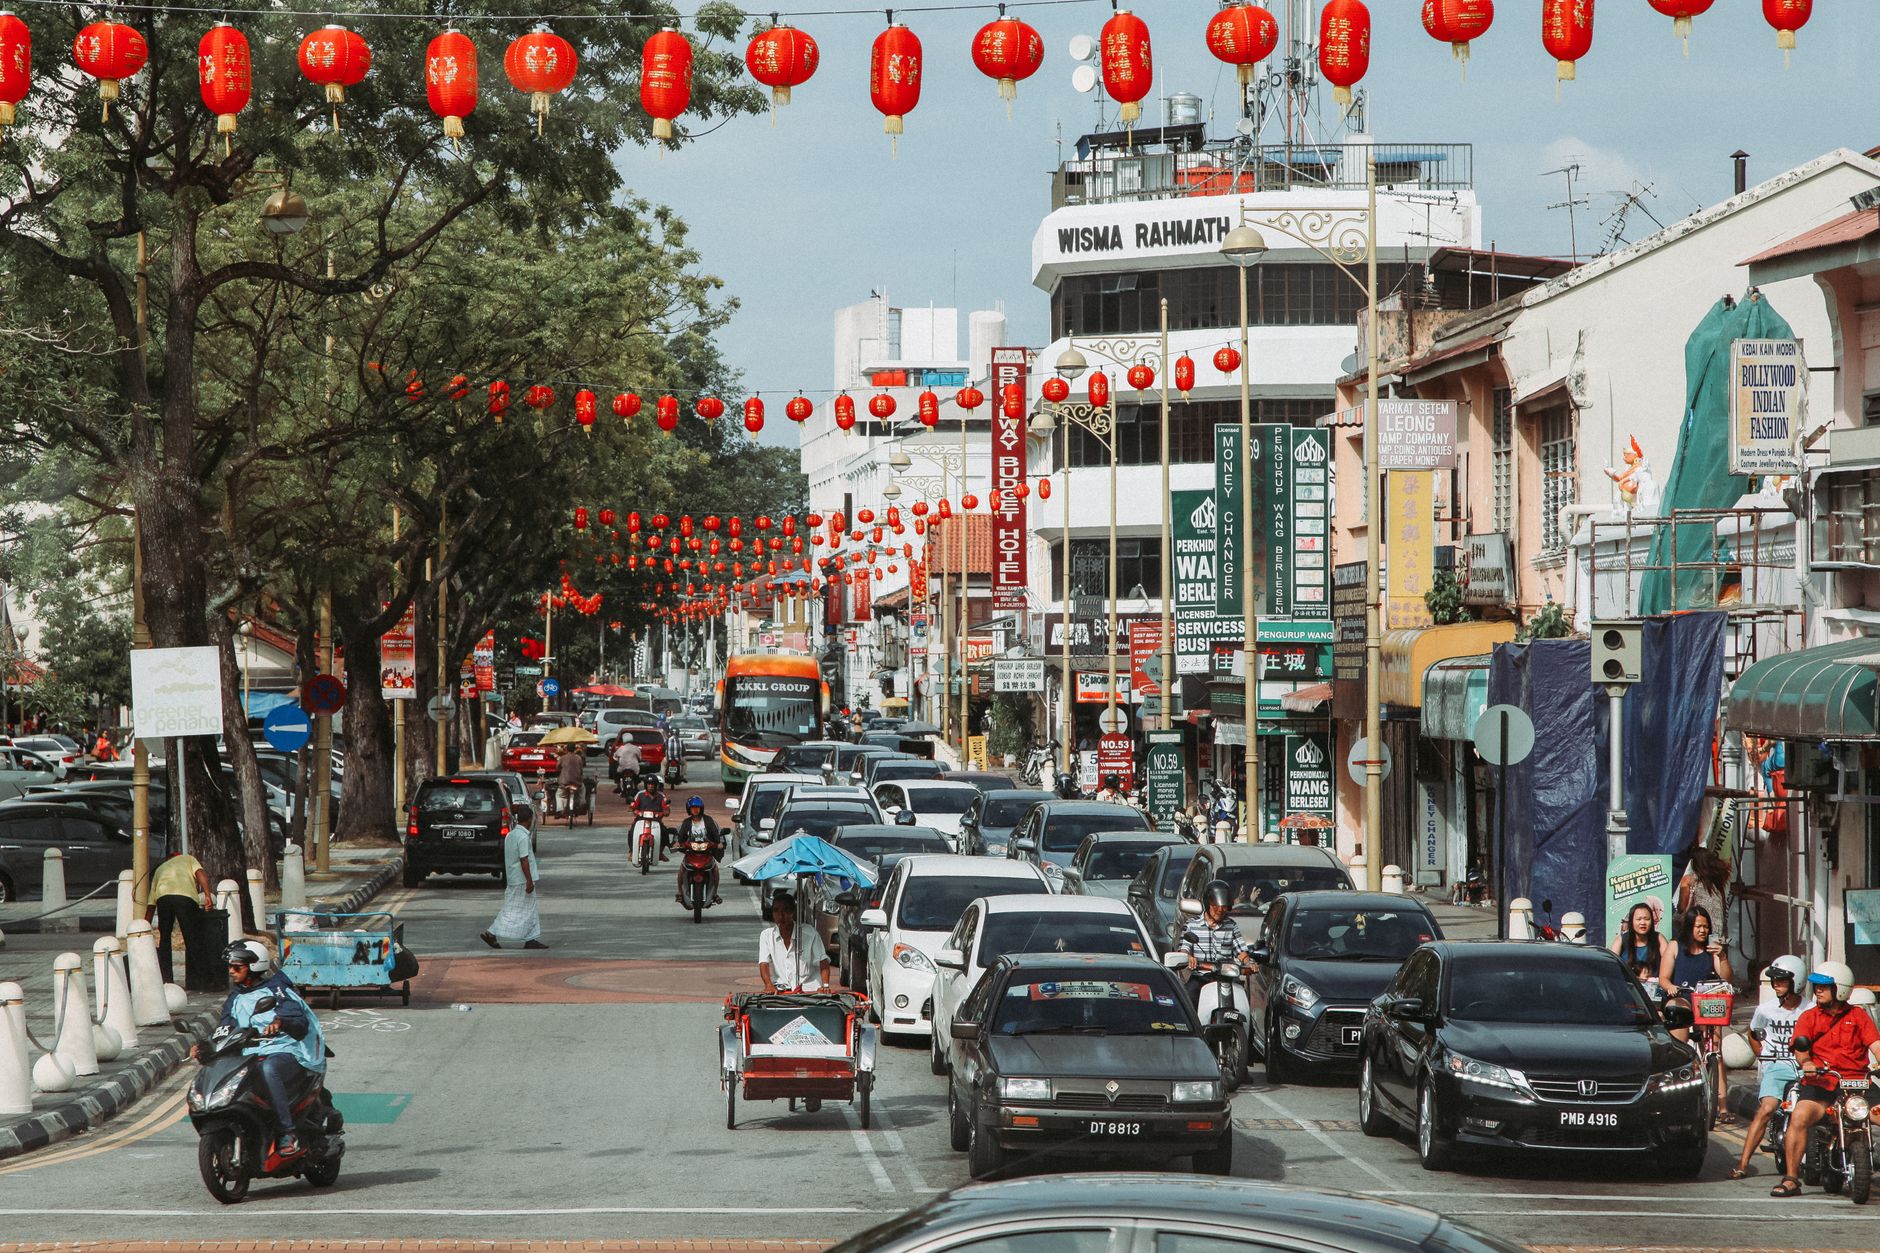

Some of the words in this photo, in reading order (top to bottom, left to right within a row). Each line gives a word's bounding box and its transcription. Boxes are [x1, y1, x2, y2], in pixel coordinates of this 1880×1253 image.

[1058, 225, 1123, 253] WISMA
[1135, 216, 1230, 248] RAHMATH
[1742, 343, 1757, 356] KEDAI
[1760, 344, 1774, 355] KAIN
[1776, 343, 1796, 355] MODEN
[1742, 365, 1796, 387] BOLLYWOOD
[1377, 402, 1413, 414] YARIKAT
[1419, 403, 1449, 414] SETEM
[1753, 391, 1786, 412] INDIAN
[1386, 416, 1435, 431] LEONG
[1750, 417, 1789, 439] FASHION
[1378, 433, 1402, 444] TAMP
[1405, 433, 1449, 444] COMPANY
[1418, 446, 1452, 455] ANTIQUES
[1771, 449, 1786, 457] Punjabi
[1223, 436, 1233, 498] MONEY
[1274, 427, 1283, 495] PENGURUP
[1381, 455, 1387, 464] &
[1390, 455, 1413, 464] PAPER
[1415, 456, 1440, 465] MONEY
[1741, 459, 1757, 467] Costume
[1759, 459, 1778, 469] Jewellery
[1000, 457, 1019, 521] BUDGET
[1273, 504, 1284, 537] WANG
[1177, 539, 1215, 552] PERKHID
[1000, 529, 1019, 583] HOTEL
[1223, 511, 1233, 599] CHANGER
[1275, 546, 1283, 614] BERLESEN
[1179, 582, 1215, 601] BERLE
[1177, 610, 1215, 619] LICENSED
[1178, 621, 1245, 634] SERVICESS
[1259, 631, 1305, 639] PENGURUP
[1307, 631, 1333, 639] WANG
[736, 683, 768, 691] KKKL
[770, 683, 810, 692] GROUP
[137, 705, 203, 725] greener
[155, 716, 219, 735] penang
[1101, 741, 1129, 749] NO.53
[1154, 754, 1177, 769] NO.59
[1290, 771, 1329, 779] PERKHIDMATAN
[1157, 789, 1176, 797] money
[1290, 781, 1329, 795] WANG
[1290, 797, 1329, 808] BERLESEN
[1428, 820, 1436, 865] CHANGER
[1610, 864, 1661, 885] Keenakan
[1615, 875, 1647, 893] MILO
[1614, 888, 1639, 899] Bentuk
[1560, 1112, 1585, 1125] PMB
[1587, 1113, 1618, 1126] 4916
[1090, 1122, 1106, 1134] DT
[1108, 1123, 1140, 1135] 8813
